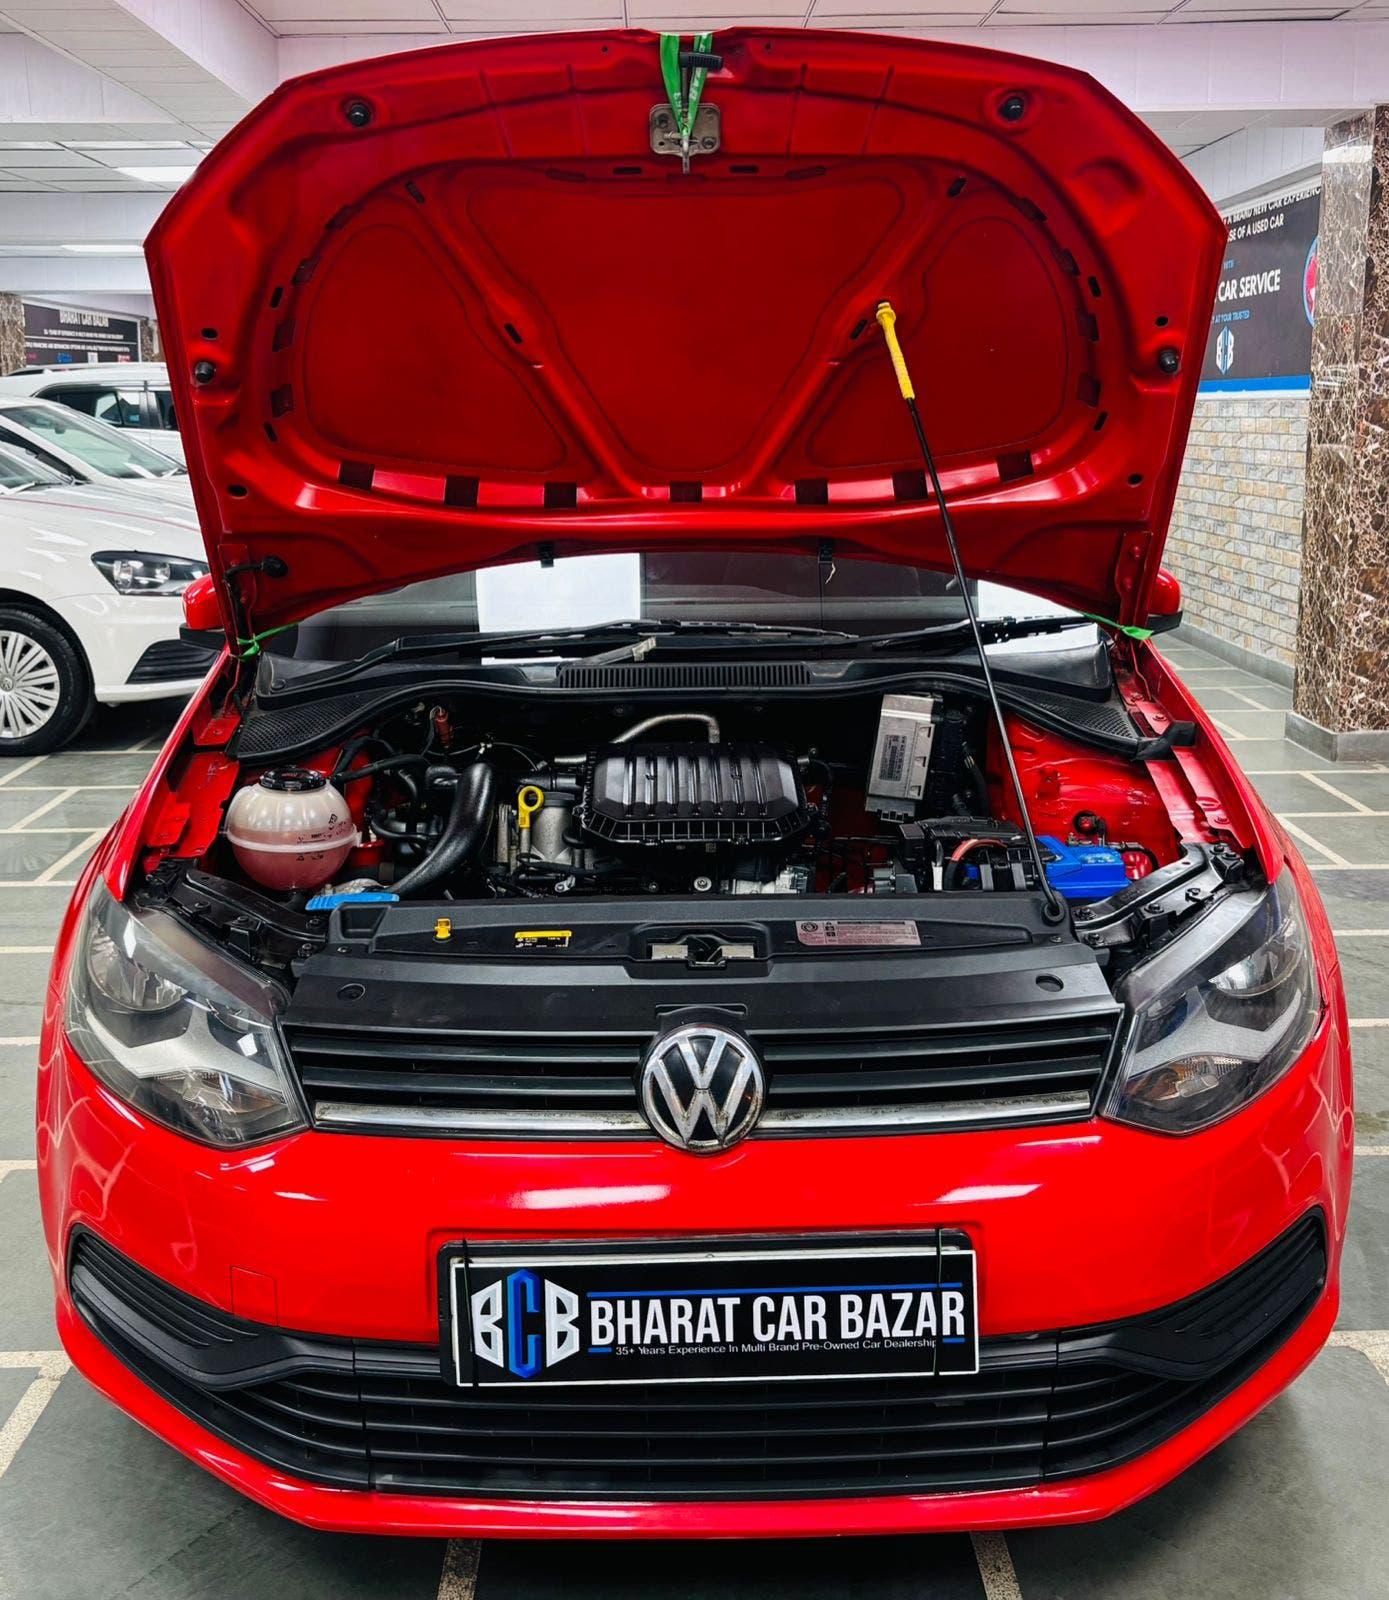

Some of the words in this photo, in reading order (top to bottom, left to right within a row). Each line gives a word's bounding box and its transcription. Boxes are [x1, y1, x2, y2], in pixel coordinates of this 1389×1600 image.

[1237, 225, 1246, 239] OF
[1246, 224, 1251, 237] A
[1252, 218, 1269, 235] USED
[1269, 213, 1285, 229] CAR
[1218, 279, 1238, 302] CAR
[1239, 269, 1281, 298] SERVICE
[590, 1297, 741, 1345] BHARAT
[752, 1295, 827, 1342] CAR
[840, 1291, 965, 1339] BAZAR
[615, 1346, 635, 1356] 35+
[638, 1346, 666, 1355] Years
[668, 1344, 726, 1356] Experience
[729, 1344, 738, 1353] In
[741, 1343, 765, 1353] Multi
[769, 1341, 799, 1352] Brand
[802, 1340, 860, 1351] Pre-Owned
[863, 1340, 881, 1350] Car
[884, 1338, 937, 1349] Dealership
